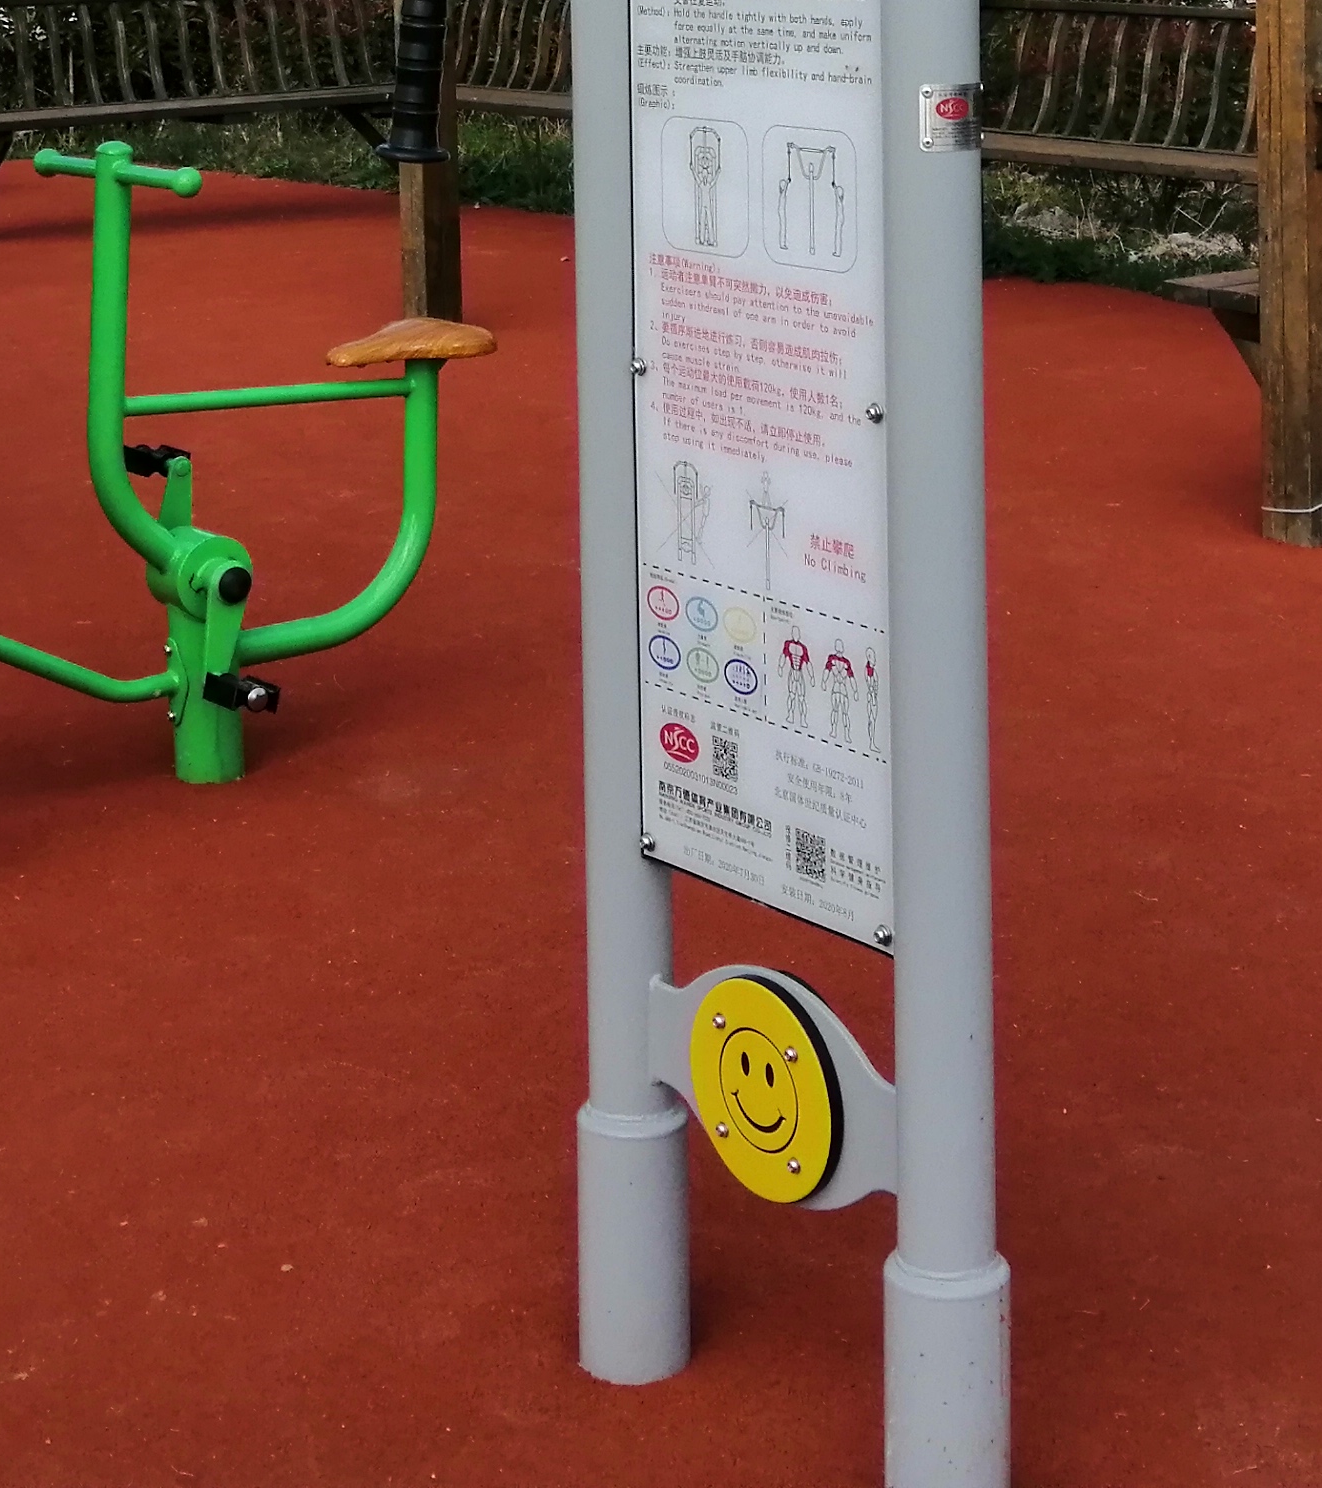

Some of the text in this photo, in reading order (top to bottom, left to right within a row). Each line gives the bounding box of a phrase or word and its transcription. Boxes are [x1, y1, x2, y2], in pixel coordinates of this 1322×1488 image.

[693, 8, 705, 19] the
[708, 9, 733, 20] handle
[736, 11, 765, 24] tightly
[768, 12, 786, 23] with
[789, 13, 807, 24] both
[674, 20, 694, 31] force
[696, 22, 724, 35] equally
[727, 24, 737, 34] at
[740, 24, 753, 35] the
[756, 26, 773, 36] same
[801, 27, 816, 38] and
[818, 29, 837, 39] make
[840, 30, 871, 42] uniform
[673, 35, 717, 47] alternating
[748, 39, 790, 52] vertically
[793, 43, 803, 53] up
[806, 42, 820, 52] and
[716, 65, 737, 75] upper
[761, 66, 807, 81] flexibility
[811, 70, 825, 81] and
[732, 295, 746, 306] pay
[749, 296, 788, 312] attention
[793, 304, 802, 315] to
[805, 305, 819, 317] the
[732, 307, 742, 318] of
[762, 313, 776, 324] arm
[780, 316, 788, 326] in
[792, 317, 814, 331] order
[819, 322, 828, 333] to
[832, 324, 856, 338] avoid
[661, 335, 670, 346] Do
[713, 346, 730, 359] step
[733, 349, 742, 361] by
[771, 356, 811, 373] otherwise
[816, 364, 825, 375] it
[828, 366, 847, 380] will
[662, 375, 674, 387] The
[710, 385, 727, 398] load
[730, 390, 743, 403] per
[785, 401, 794, 412] is
[829, 410, 843, 422] and
[847, 414, 861, 426] the
[690, 396, 699, 406] of
[702, 399, 723, 411] users
[728, 404, 735, 413] is
[662, 415, 670, 426] If
[674, 418, 695, 432] there
[699, 424, 707, 435] is
[711, 429, 723, 440] any
[773, 441, 799, 457] during
[824, 451, 853, 469] please
[682, 435, 703, 449] using
[708, 441, 715, 451] it
[810, 532, 854, 559] 禁止攀爬
[804, 552, 866, 584] No Climbing
[664, 727, 695, 753] NSCC
